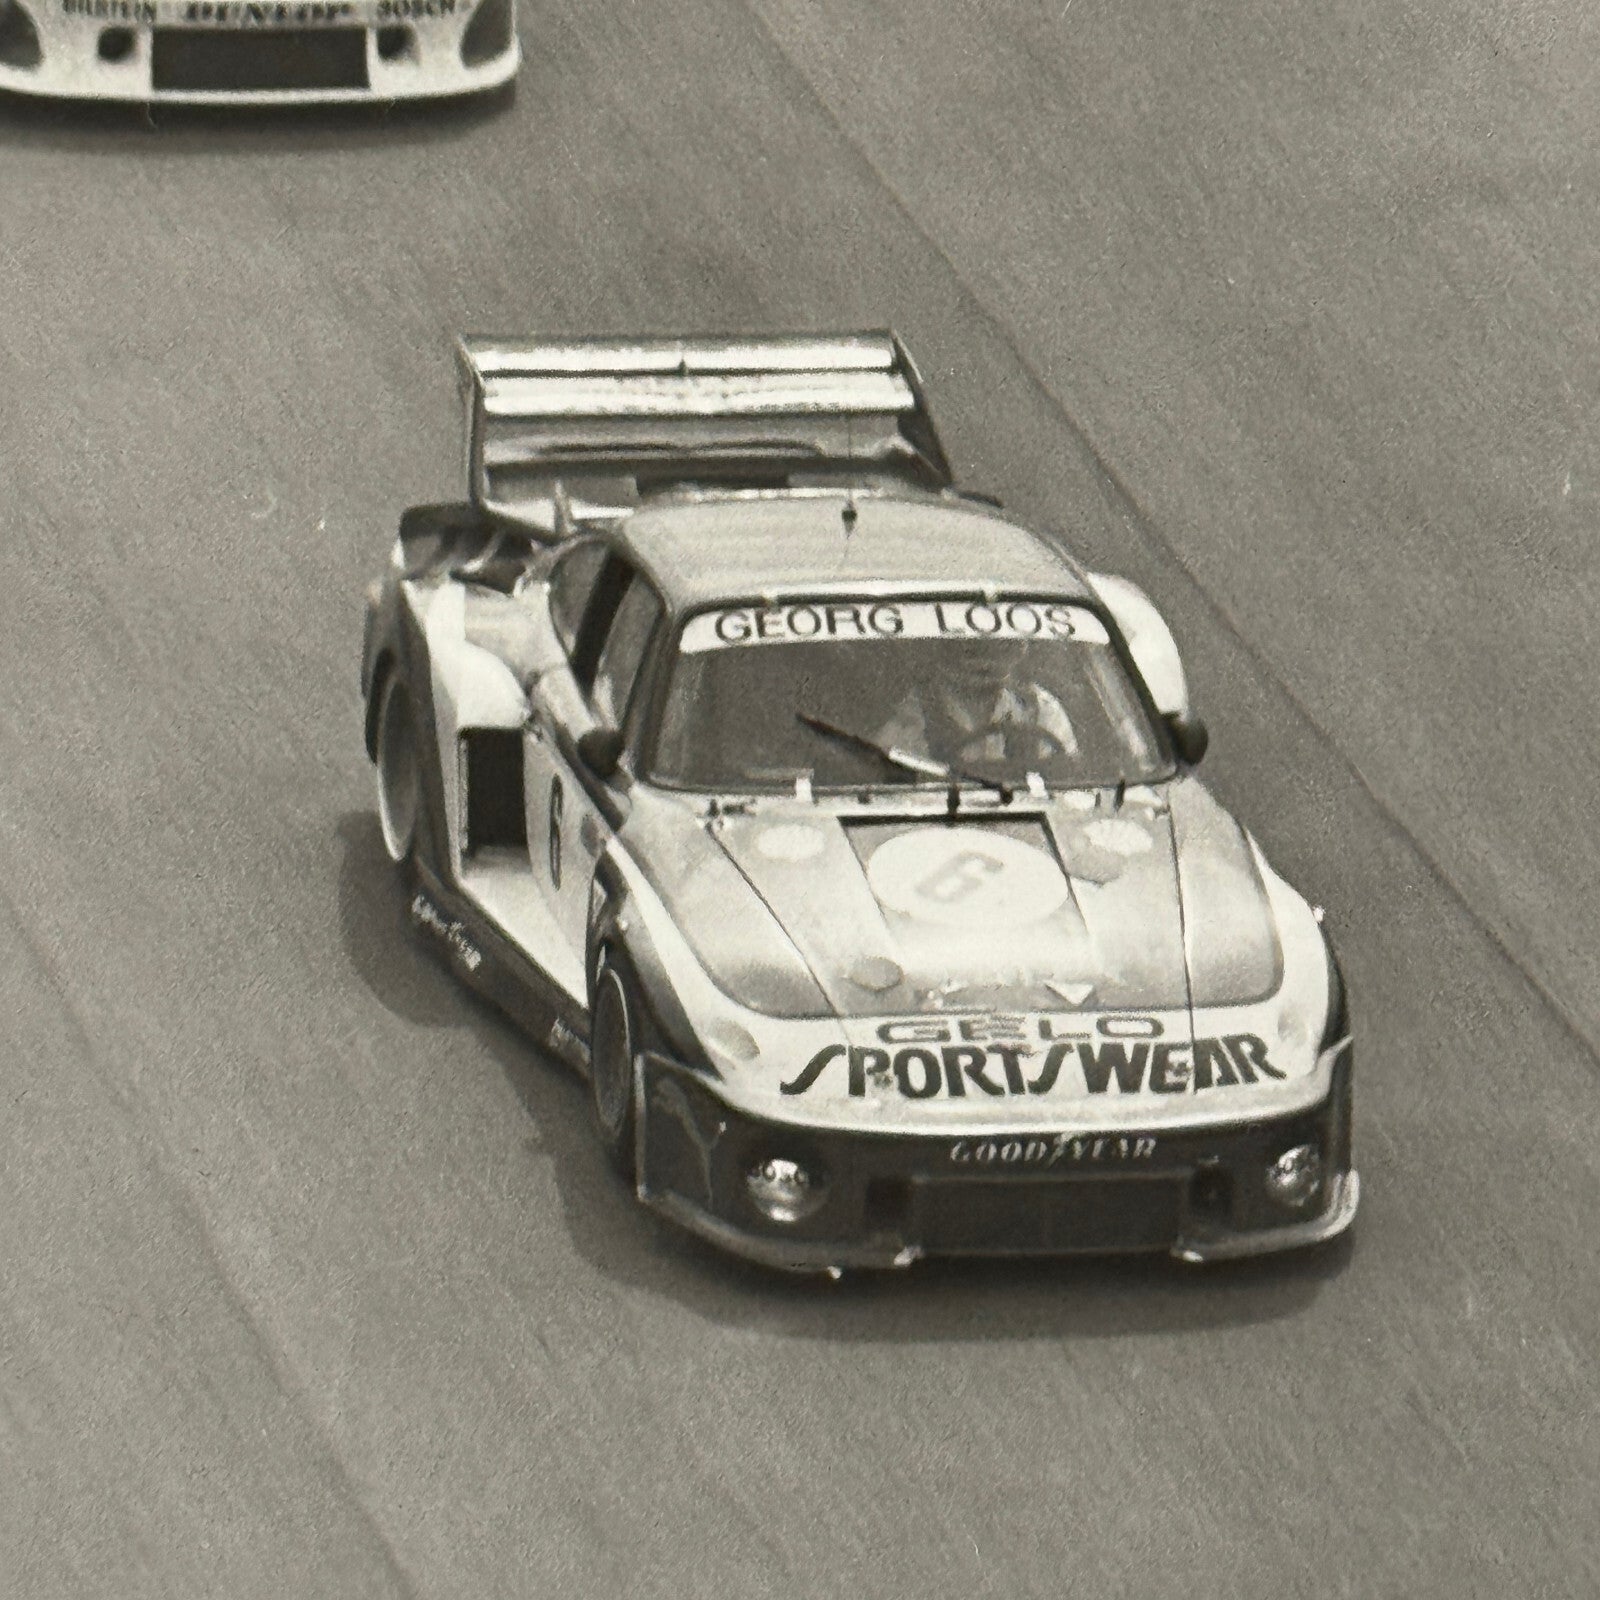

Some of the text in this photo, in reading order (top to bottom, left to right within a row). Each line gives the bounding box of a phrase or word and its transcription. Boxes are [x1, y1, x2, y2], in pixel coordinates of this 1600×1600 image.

[714, 600, 1076, 643] GEORG LOOS
[915, 852, 1003, 902] 6
[875, 1015, 1165, 1044] GELO
[779, 1032, 1288, 1099] SPORTSWEAR
[950, 1135, 1157, 1168] GOODYEAR
